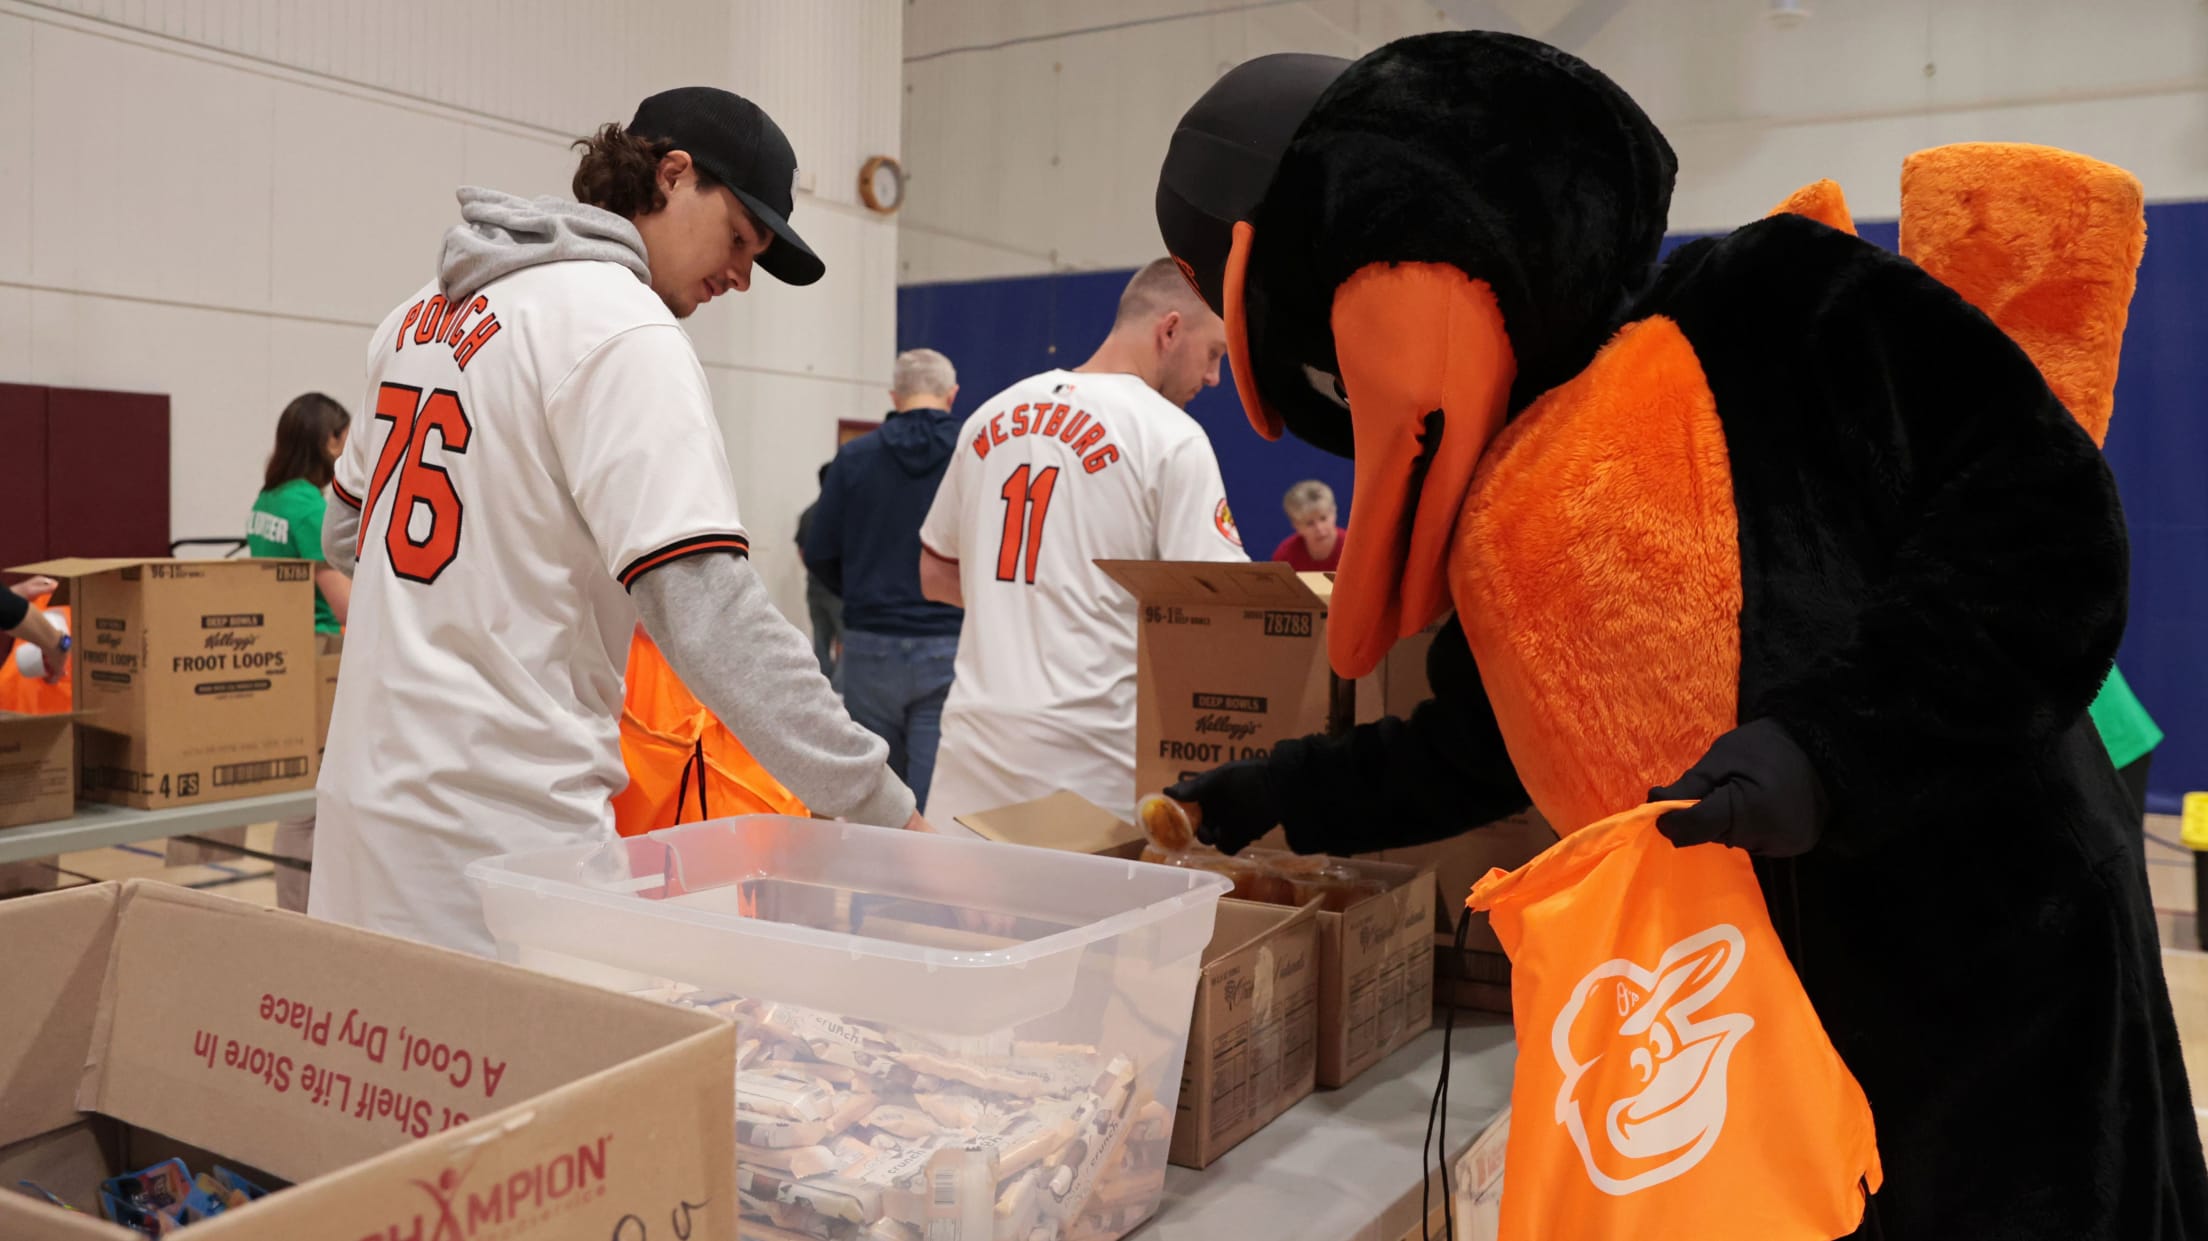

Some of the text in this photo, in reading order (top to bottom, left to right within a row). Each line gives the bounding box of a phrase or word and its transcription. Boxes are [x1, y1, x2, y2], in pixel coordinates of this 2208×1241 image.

[972, 402, 1120, 475] WESTBURG
[355, 381, 473, 585] 76
[996, 463, 1060, 585] 11
[1145, 606, 1173, 624] 96-1
[1266, 612, 1310, 636] 78788
[172, 651, 285, 673] FROOT LOOPS
[1198, 695, 1260, 711] DEEP BOWLS
[1194, 713, 1257, 740] Kellogg's
[1160, 740, 1271, 763] FROOT LOO
[159, 774, 171, 799] 4
[815, 1016, 859, 1044] crunch
[194, 1029, 218, 1069] In
[259, 993, 507, 1098] A Cool, Dry Place
[224, 1039, 294, 1093] Store
[301, 1064, 352, 1112] Life
[354, 1082, 433, 1139] Shelf
[887, 1149, 926, 1174] crunch
